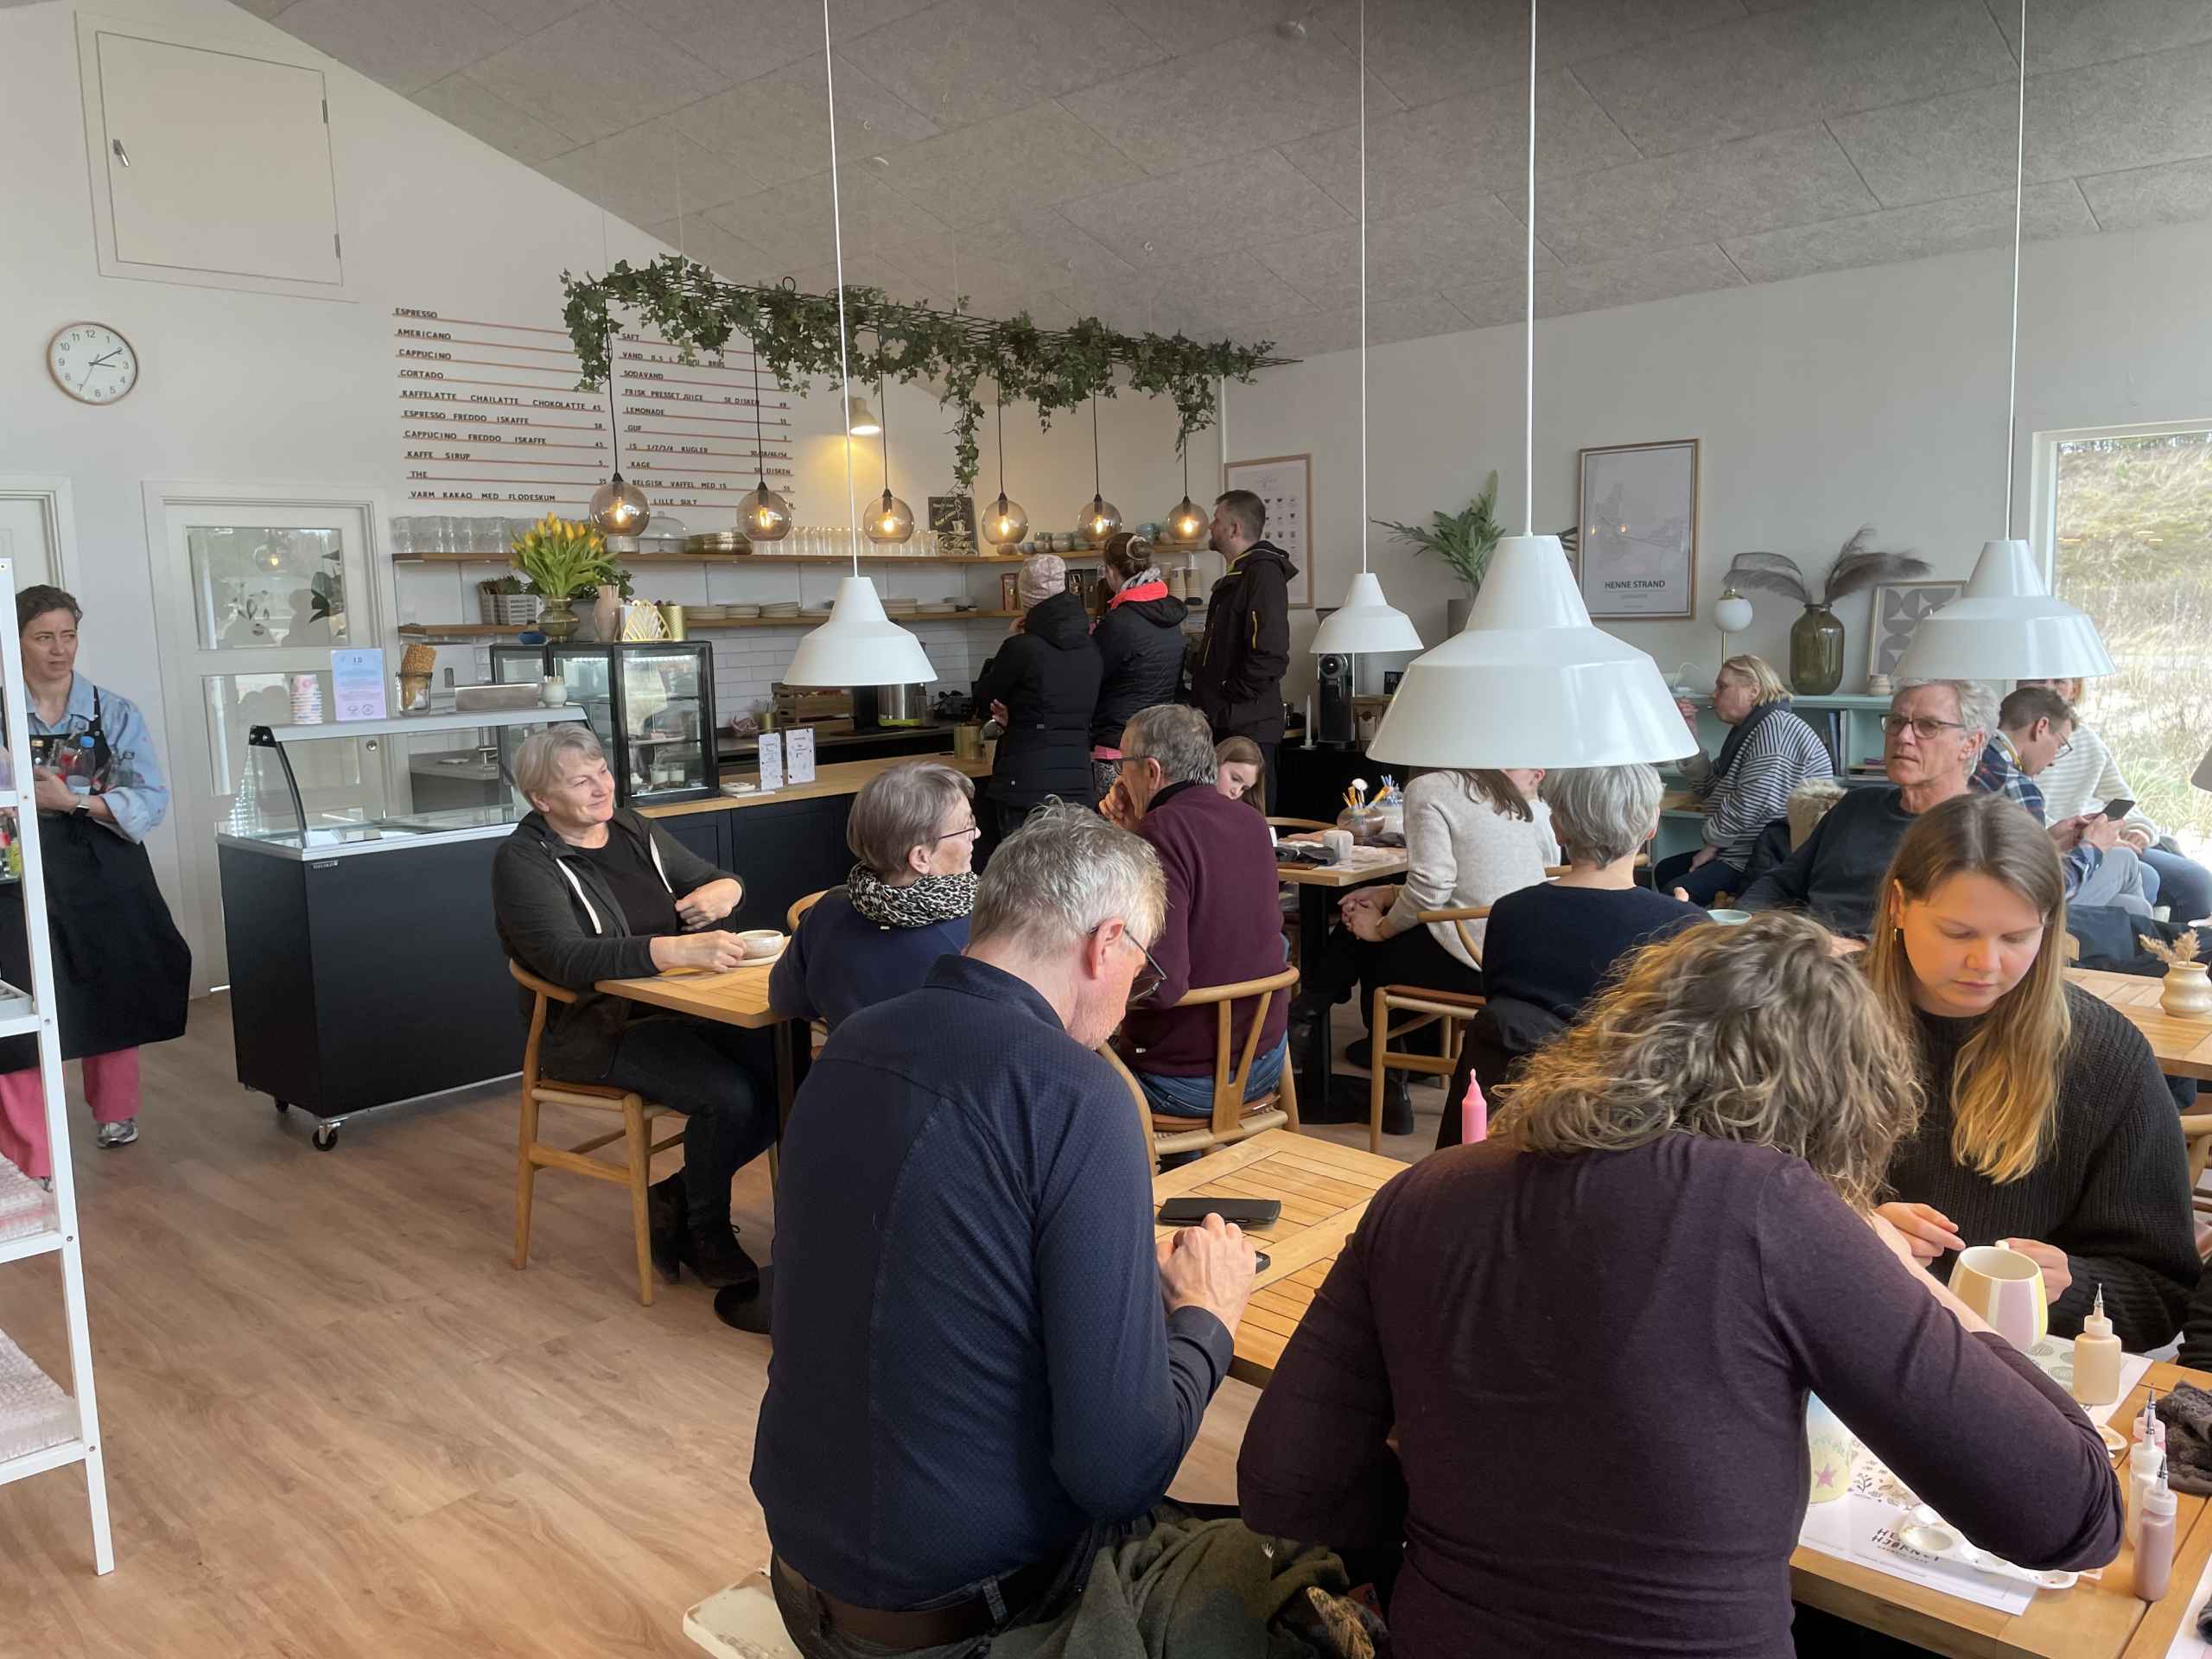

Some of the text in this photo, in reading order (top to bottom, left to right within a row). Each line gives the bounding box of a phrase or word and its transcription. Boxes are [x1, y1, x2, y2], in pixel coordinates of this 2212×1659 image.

[395, 308, 437, 319] ESPRESSO
[72, 333, 80, 341] 11
[86, 329, 96, 338] 12
[397, 328, 451, 340] AMERICANO
[60, 341, 70, 351] 10
[399, 349, 451, 360] CAPPUCINO
[622, 352, 643, 360] VAND
[58, 358, 65, 366] 9
[123, 361, 130, 370] 3
[400, 369, 443, 379] CORTADO
[624, 370, 664, 380] SODAVAND
[95, 389, 101, 397] 6
[110, 385, 116, 394] 5
[625, 388, 645, 397] FRISK
[651, 390, 680, 400] PRESSET
[402, 390, 456, 401] KAFFELATTE
[626, 407, 664, 416] LEMONADE
[404, 410, 446, 419] ESPRESSO
[454, 413, 486, 422] FREDDO
[497, 416, 529, 424] ISKAFFE
[404, 430, 457, 440] CAPPUCINO
[468, 434, 501, 442] FREDDO
[515, 436, 546, 445] ISKAFFE
[407, 450, 433, 459] KAFFE
[445, 452, 471, 461] SIRUP
[631, 461, 651, 470] KAGE
[632, 480, 663, 488] BELGISK
[671, 481, 695, 490] VAFFEL
[1605, 580, 1666, 589] HENNE STRAND
